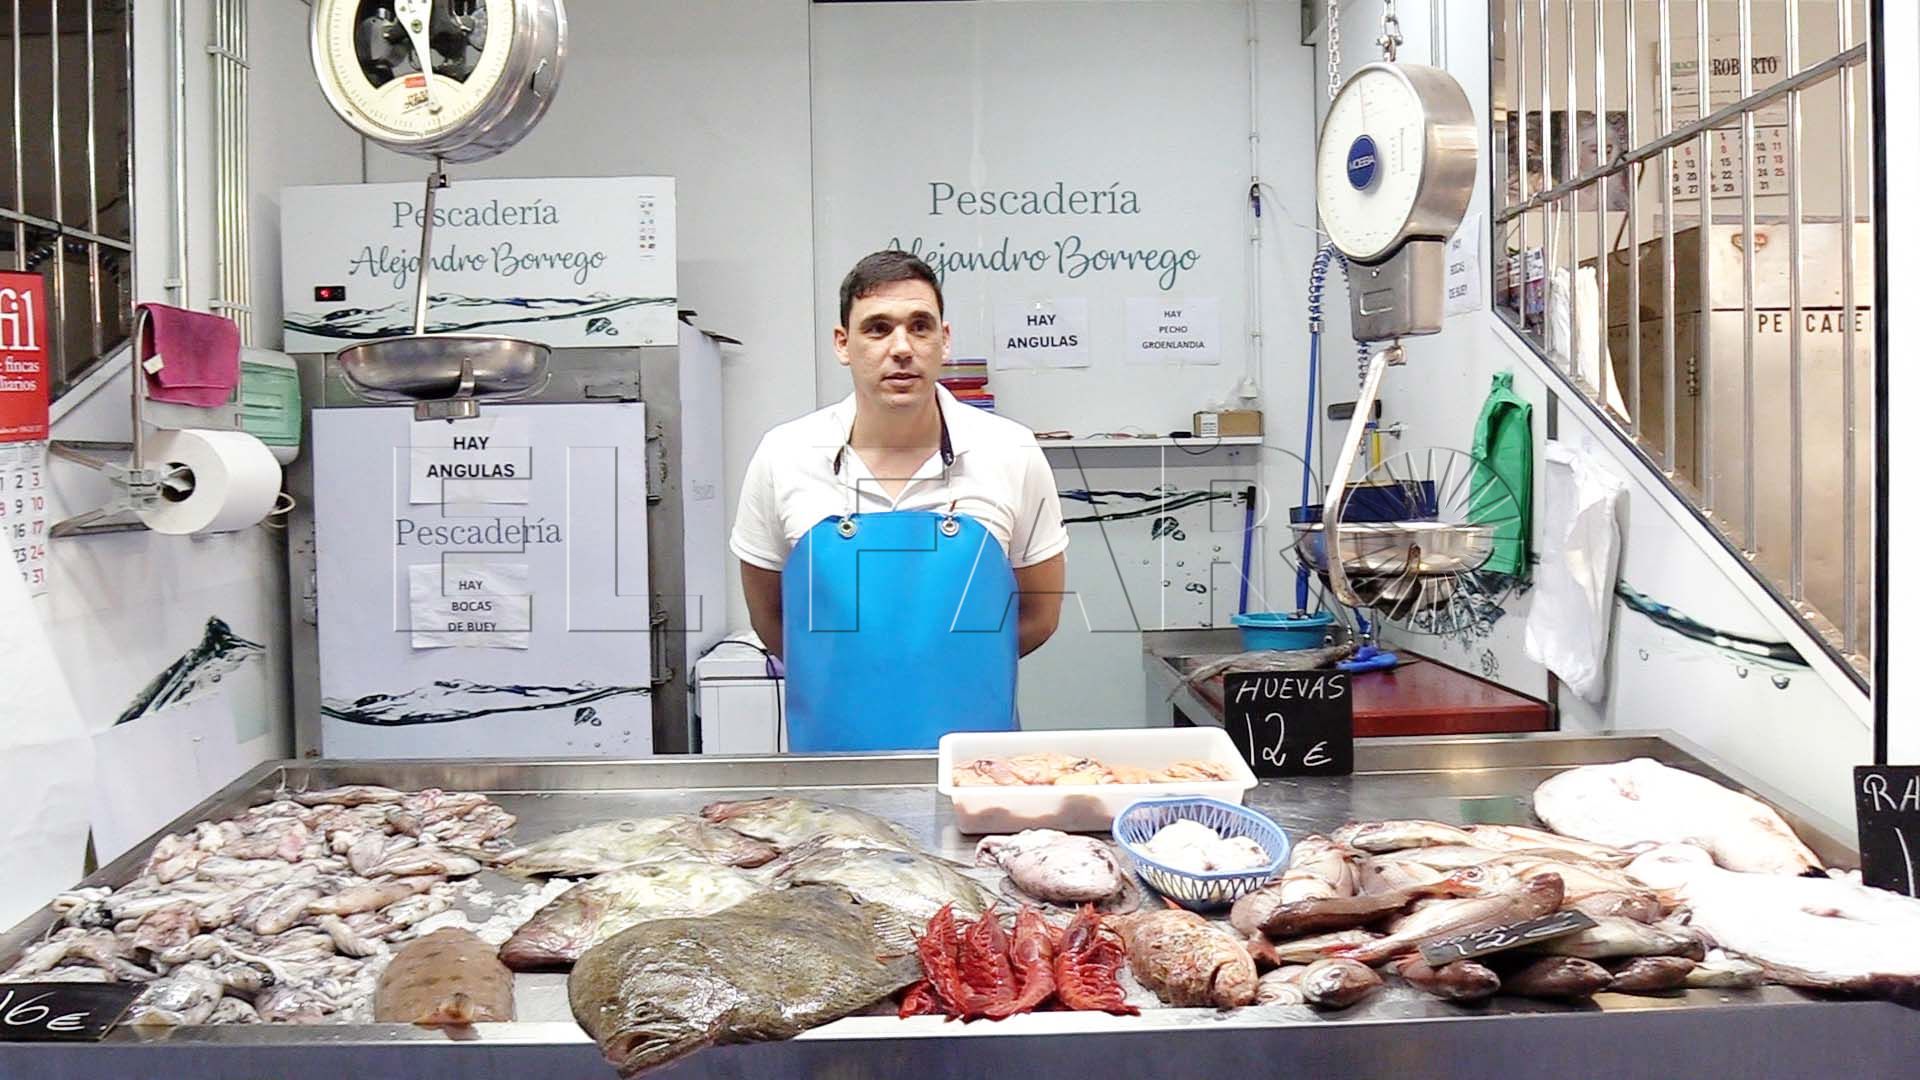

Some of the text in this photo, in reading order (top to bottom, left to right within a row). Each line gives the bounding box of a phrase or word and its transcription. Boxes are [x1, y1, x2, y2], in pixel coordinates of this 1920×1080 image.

[1712, 56, 1777, 76] ROBRTO
[928, 181, 1141, 217] Pescadería
[392, 198, 560, 228] Pescadería
[490, 241, 607, 286] Borrego
[1054, 234, 1202, 291] Borrego
[1026, 313, 1056, 327] HAY
[1164, 310, 1182, 318] HAY
[1159, 325, 1188, 334] PECHO
[1006, 334, 1079, 350] ANGULAS
[1142, 340, 1205, 350] GROENLANDIA
[452, 436, 490, 450] HAY
[426, 462, 515, 479] ANGULAS
[395, 517, 562, 546] Pescadería
[458, 579, 482, 591] HAY
[451, 601, 492, 612] BOCAS
[448, 621, 497, 633] DE BUEY
[1235, 673, 1345, 704] HUEVAS
[1244, 711, 1333, 768] 12 €
